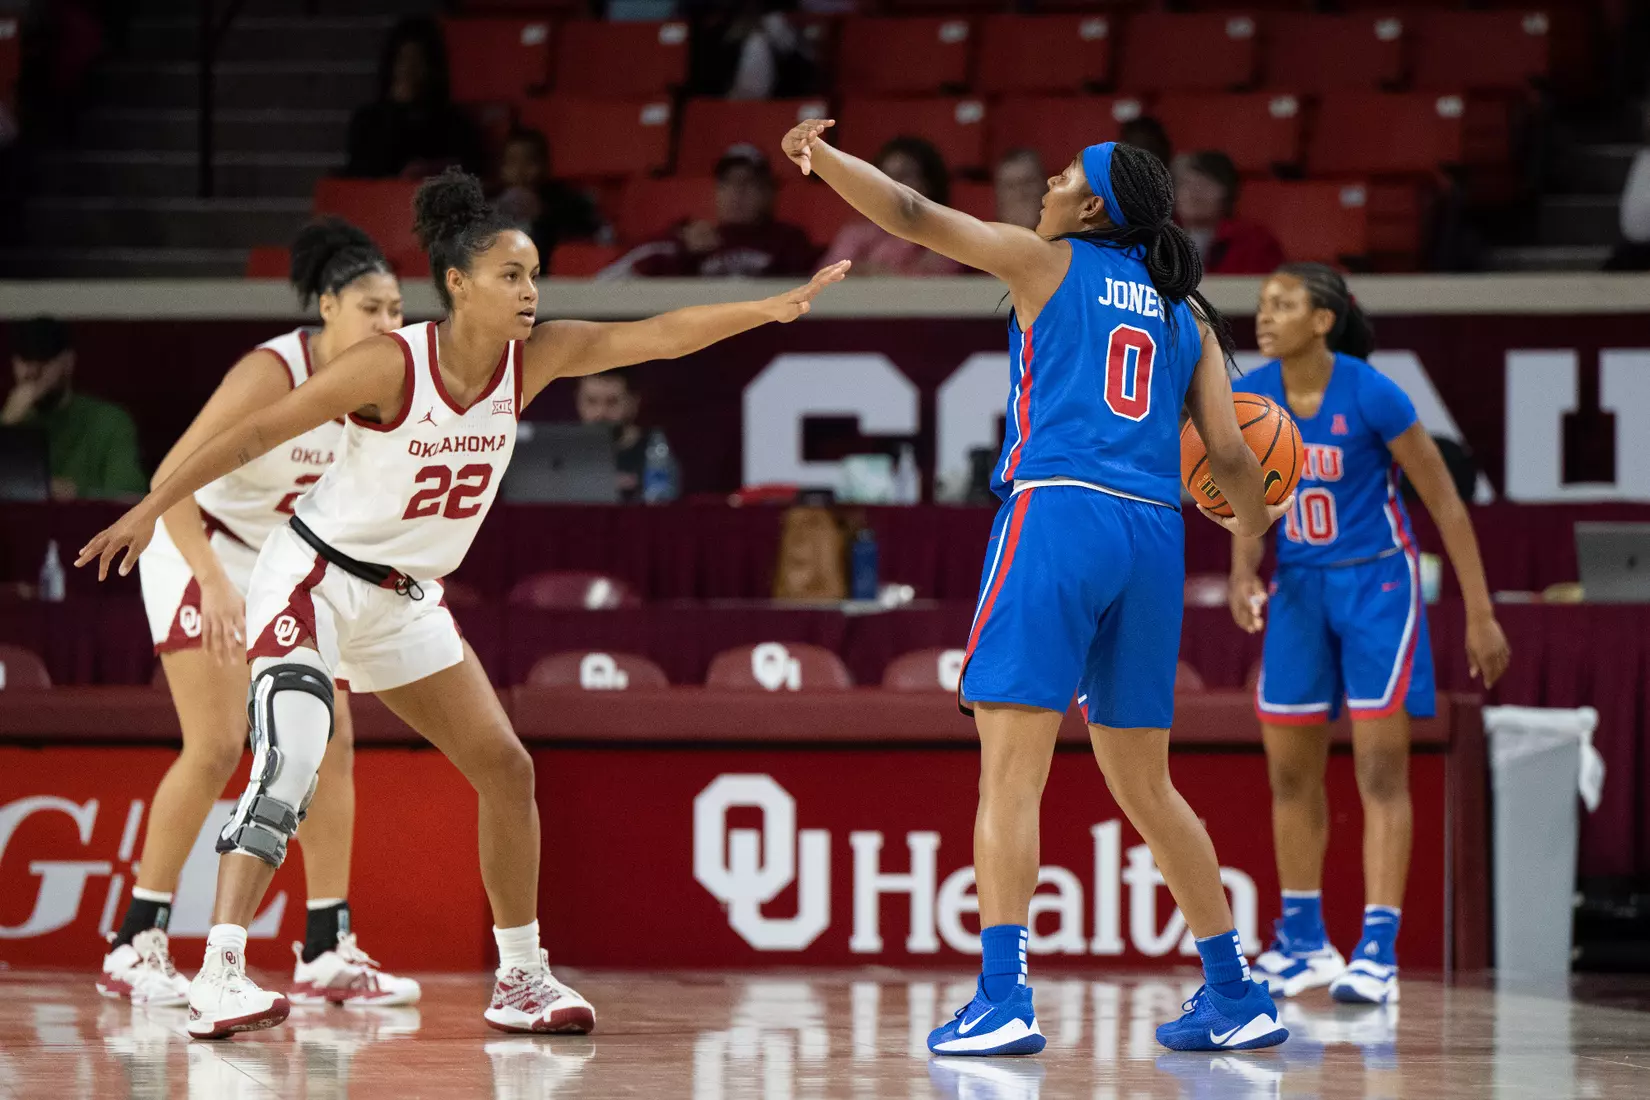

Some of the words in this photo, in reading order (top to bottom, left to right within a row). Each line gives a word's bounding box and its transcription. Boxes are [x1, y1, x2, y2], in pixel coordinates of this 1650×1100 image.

[1104, 323, 1156, 422] 0
[402, 463, 493, 519] 22
[274, 615, 300, 647] OU
[693, 773, 831, 951] OU
